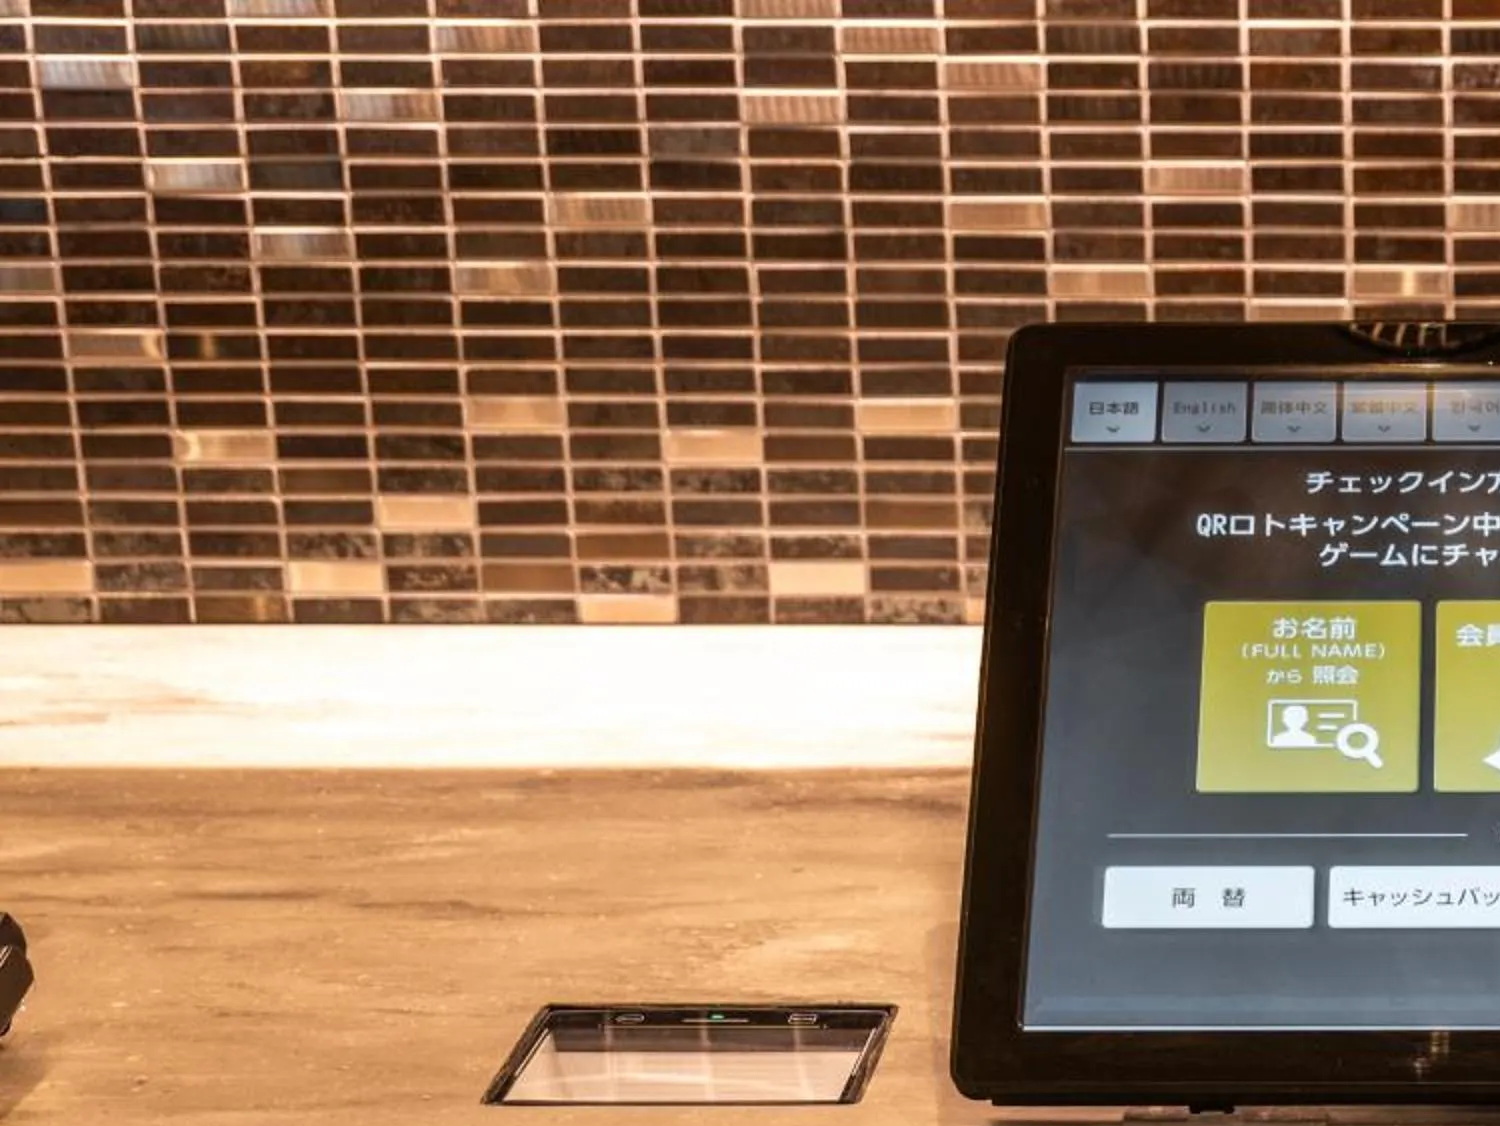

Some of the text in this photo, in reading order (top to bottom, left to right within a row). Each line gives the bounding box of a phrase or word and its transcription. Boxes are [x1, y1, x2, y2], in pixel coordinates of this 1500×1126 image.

[1088, 401, 1140, 416] 日本語
[1172, 401, 1237, 416] English
[1271, 616, 1358, 640] お名前
